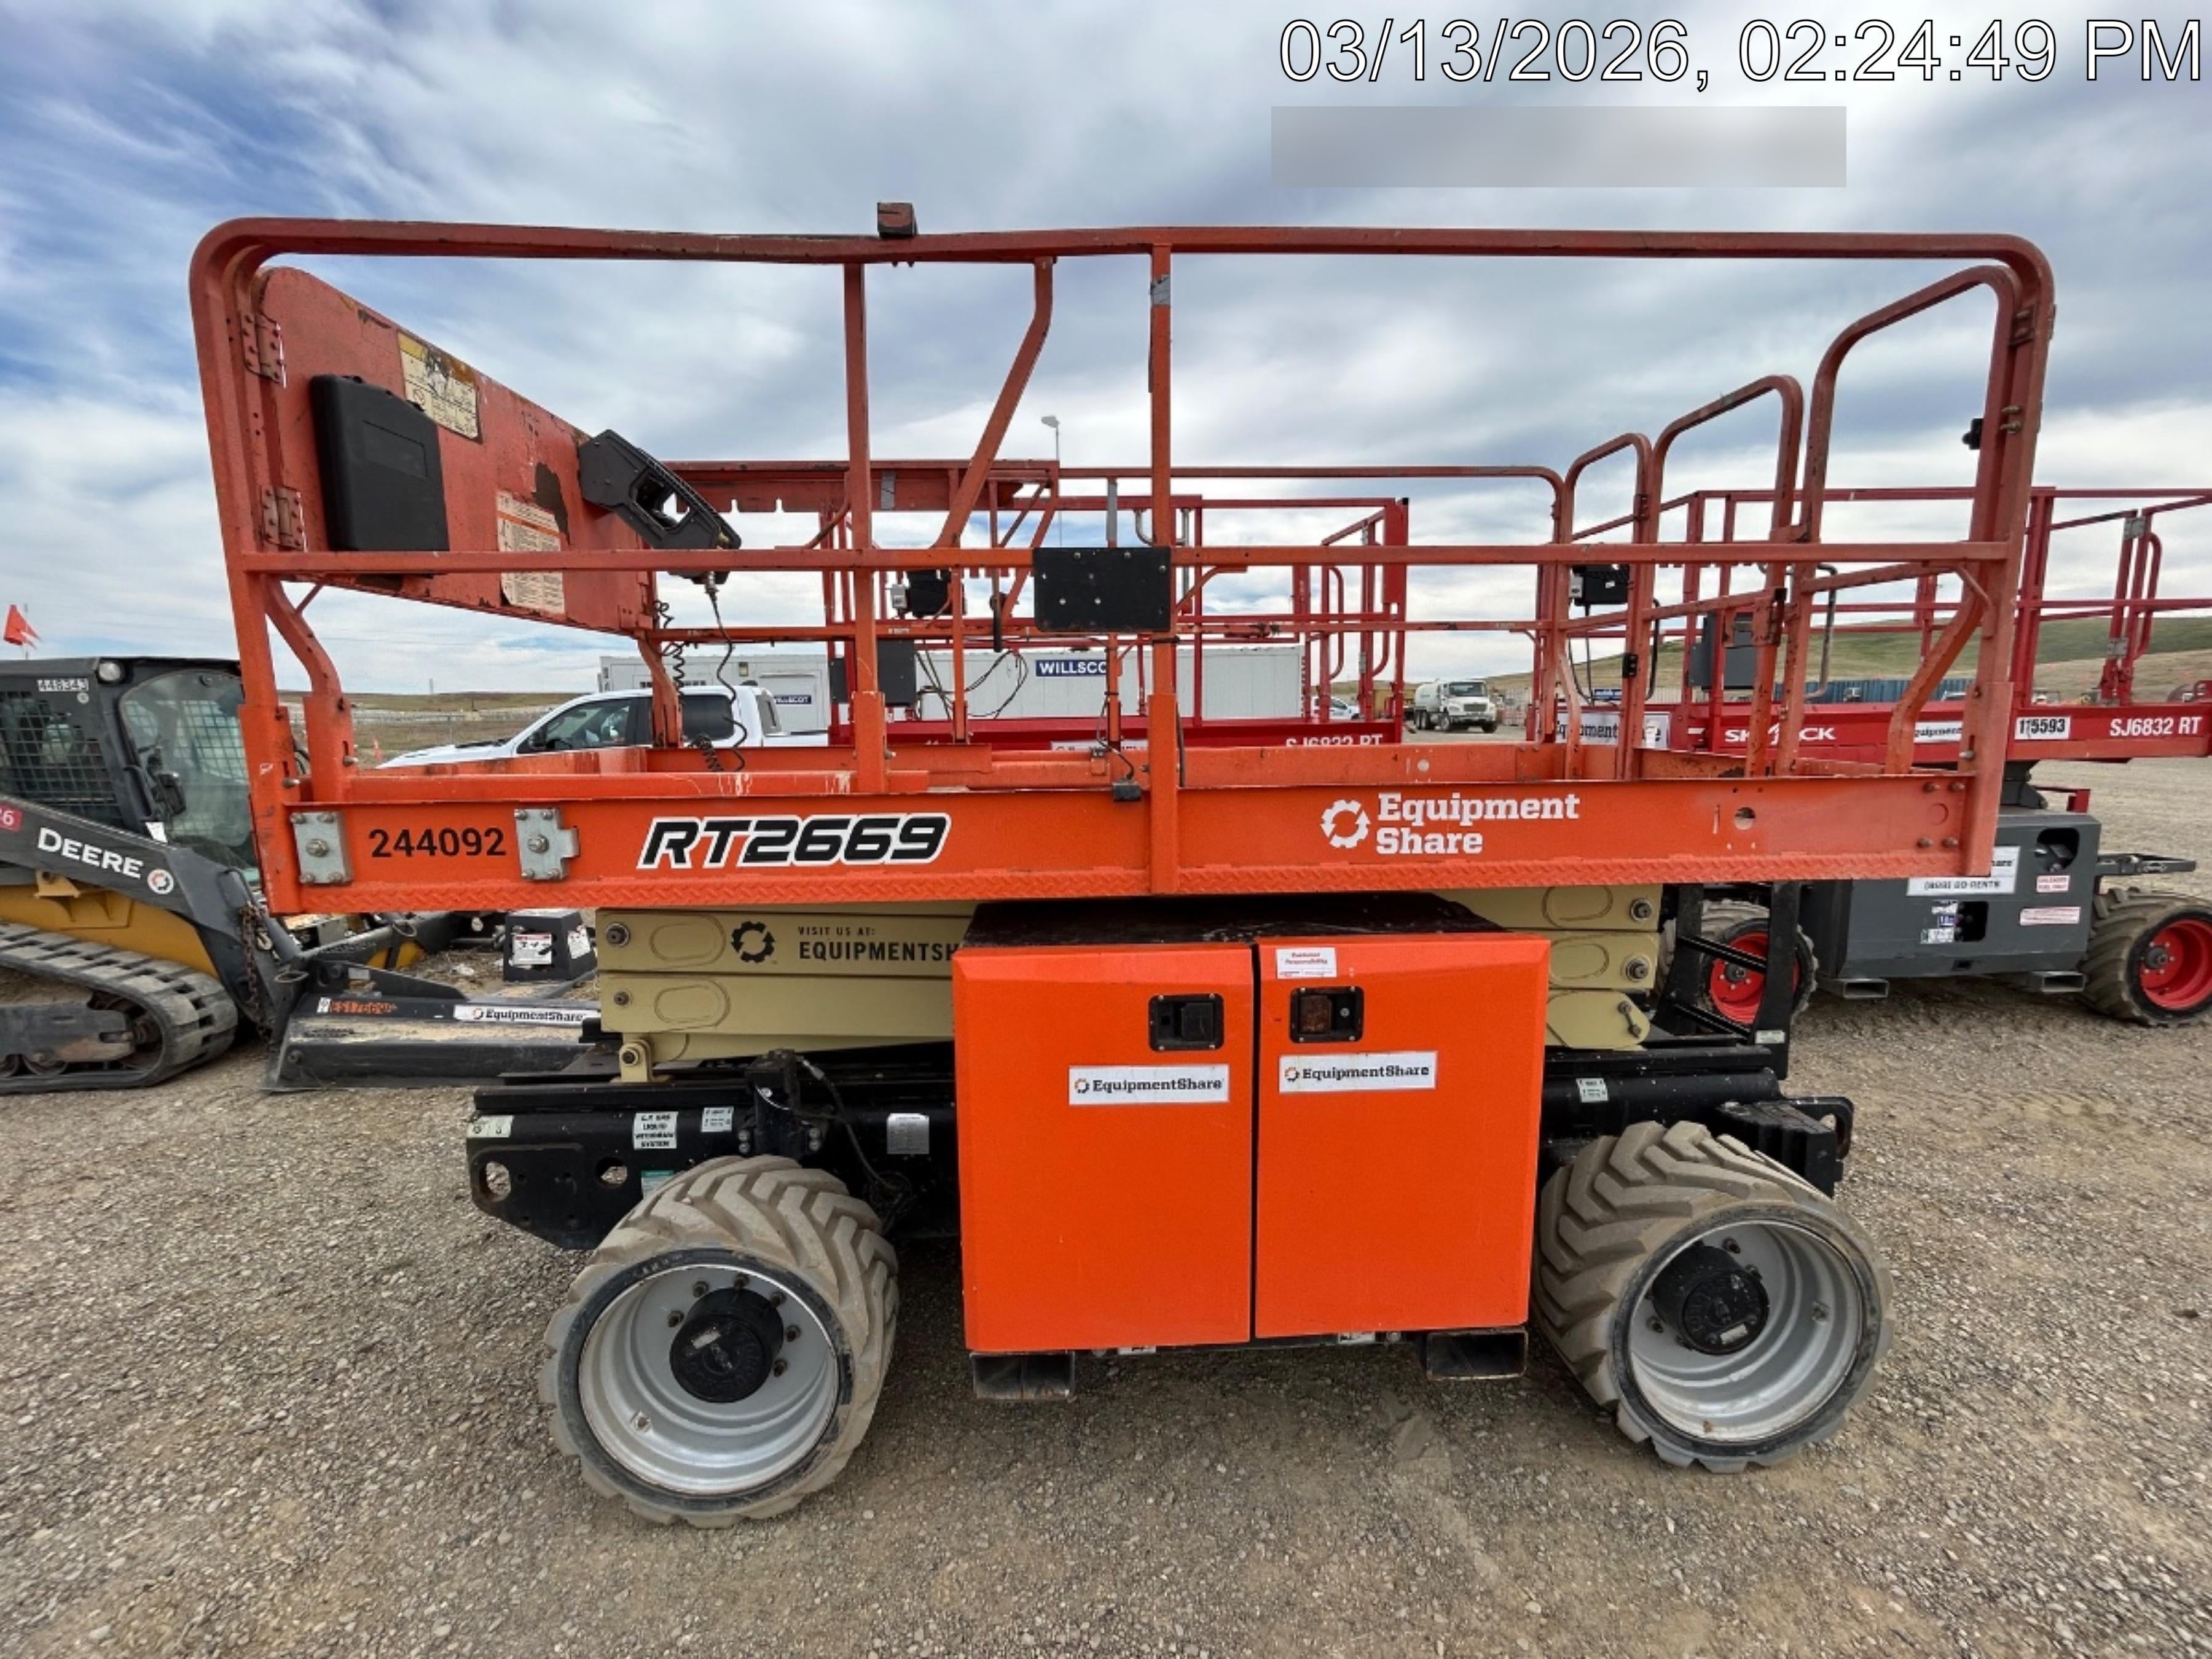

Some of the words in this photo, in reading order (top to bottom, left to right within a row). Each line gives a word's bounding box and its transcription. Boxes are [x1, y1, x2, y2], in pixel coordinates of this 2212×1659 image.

[1040, 662, 1106, 673] WILLSCO
[2110, 717, 2174, 737] SJ6832
[2178, 716, 2202, 735] RT
[0, 809, 14, 826] 6
[1377, 792, 1580, 826] Equipment
[369, 827, 507, 858] 244092
[638, 814, 951, 868] RT2669
[1376, 827, 1483, 855] Share
[37, 826, 144, 879] DEERE
[798, 927, 830, 935] VISIT
[836, 927, 851, 936] US
[857, 927, 876, 936] AT:
[1303, 1065, 1429, 1081] EquipmentShare
[1092, 1078, 1222, 1093] EquipmentShare
